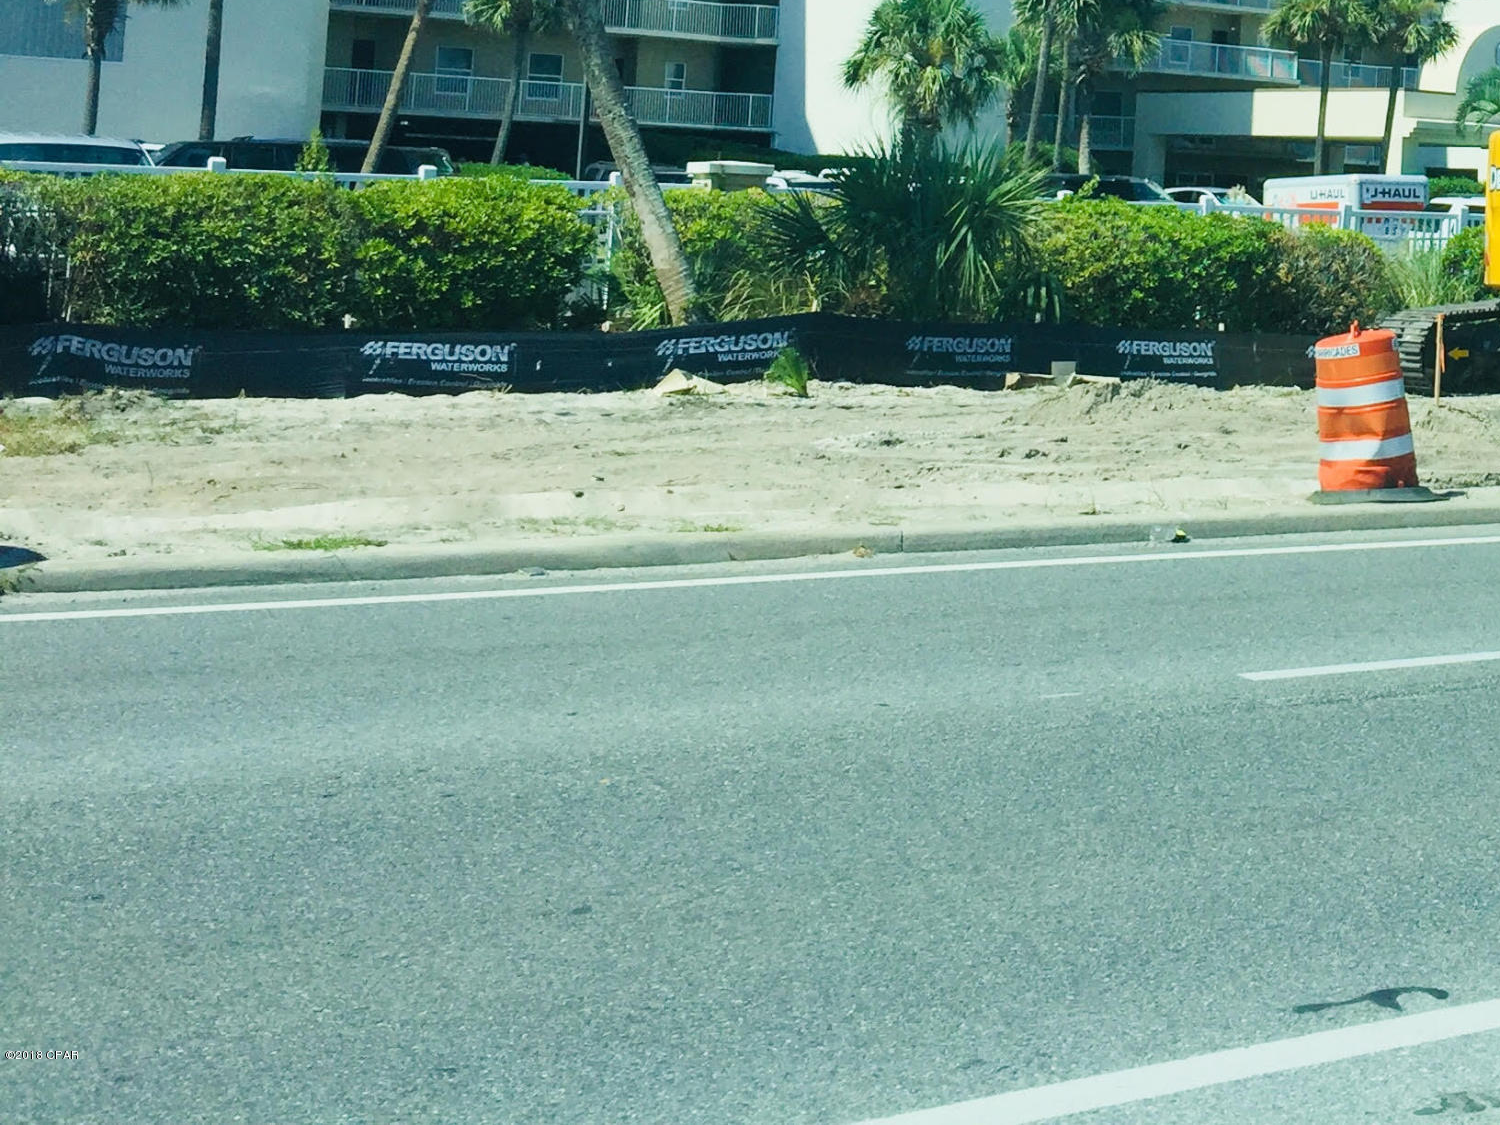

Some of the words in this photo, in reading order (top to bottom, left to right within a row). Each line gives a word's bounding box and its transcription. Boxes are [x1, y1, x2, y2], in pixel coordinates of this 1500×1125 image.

[1310, 188, 1345, 200] U-HAUL
[1366, 187, 1421, 199] U-HAUL
[56, 334, 192, 366] FERGUSON
[677, 331, 789, 355] FERGUSON
[923, 336, 1012, 353] FERGUSON
[1132, 340, 1213, 356] FERGUSON
[386, 341, 510, 362] FERGUSON
[717, 350, 783, 362] WATERWORK
[105, 363, 190, 378] WATERWORKS
[431, 362, 509, 373] WATERWORKS
